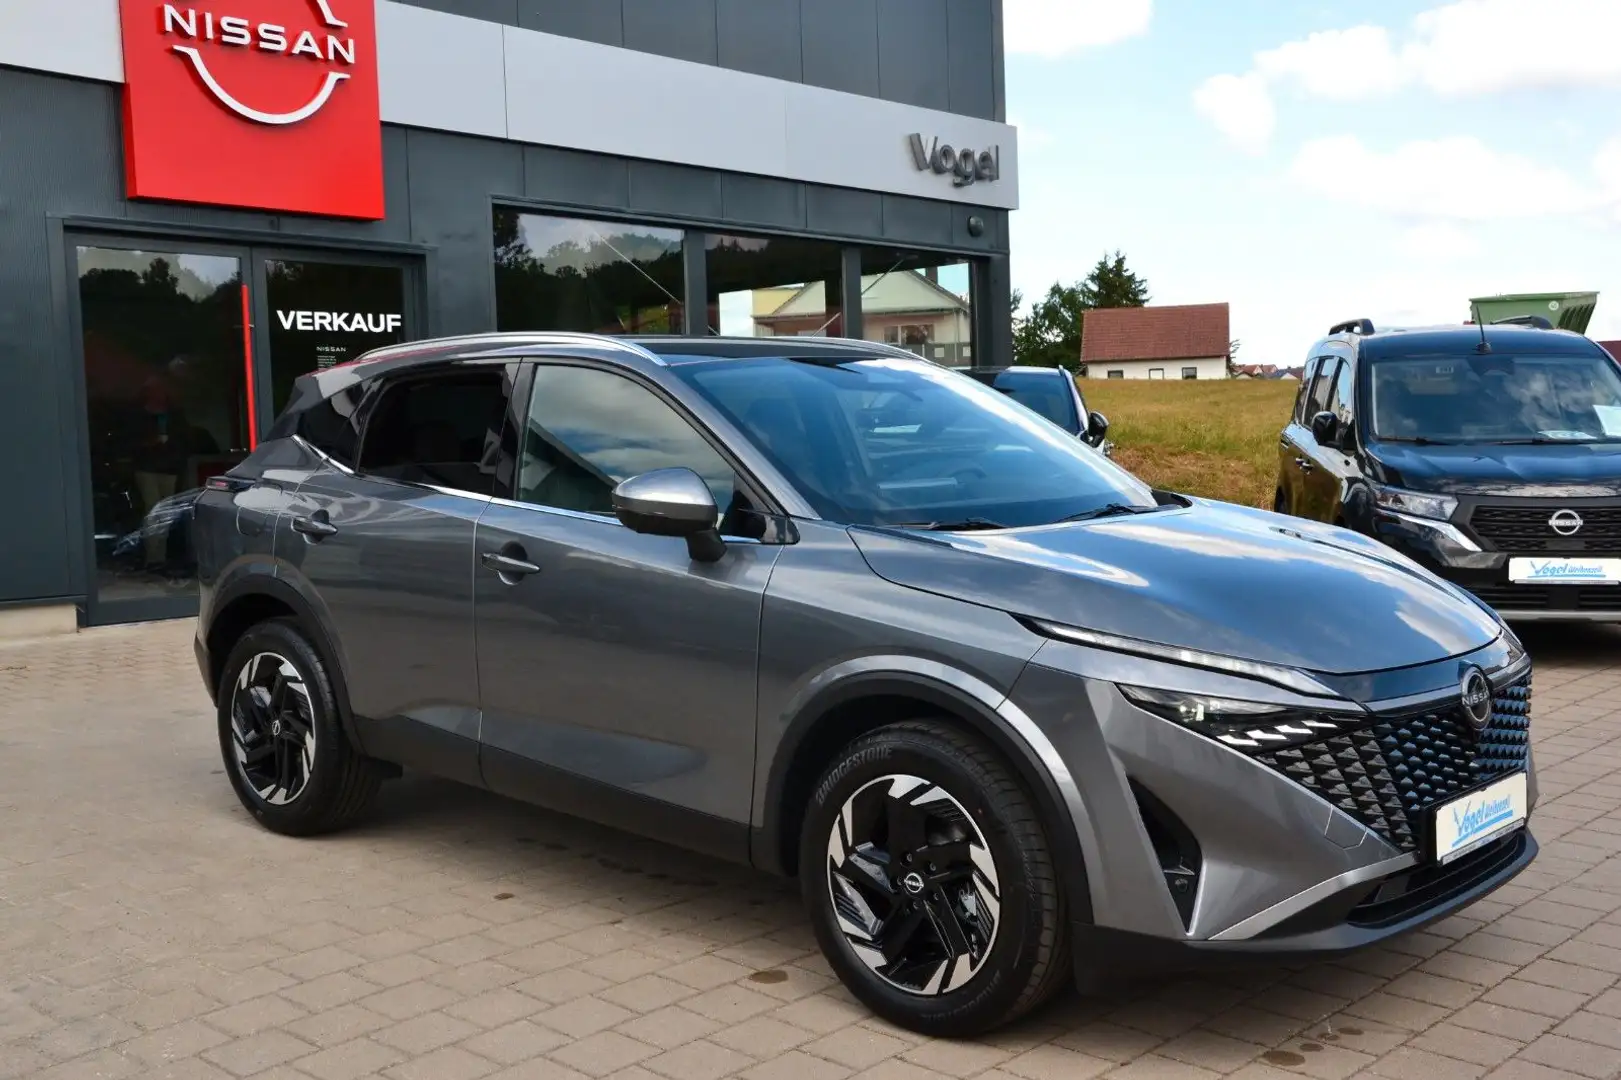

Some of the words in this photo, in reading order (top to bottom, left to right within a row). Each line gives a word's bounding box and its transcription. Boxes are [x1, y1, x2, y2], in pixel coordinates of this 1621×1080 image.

[163, 4, 355, 64] NISSAN
[909, 132, 999, 188] Vogel
[276, 310, 402, 333] VERKAUF
[1529, 560, 1568, 576] Vogel
[1453, 800, 1485, 837] Vogel
